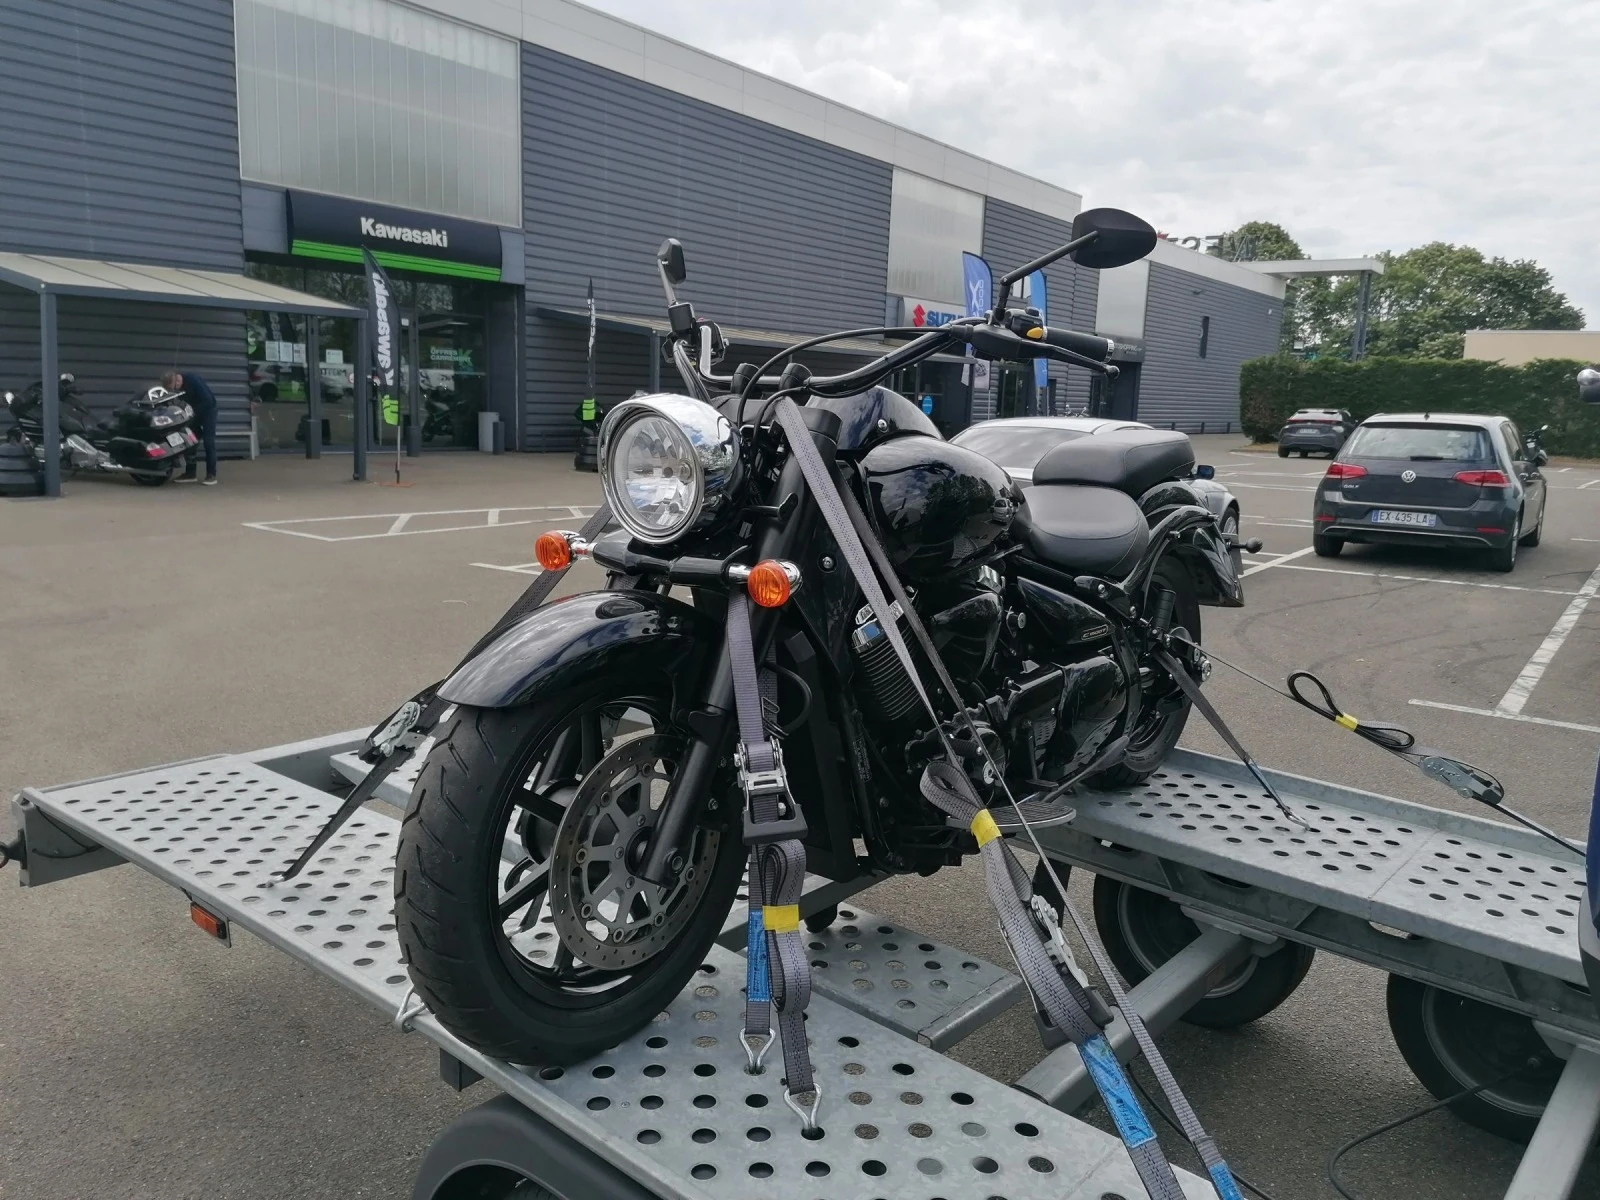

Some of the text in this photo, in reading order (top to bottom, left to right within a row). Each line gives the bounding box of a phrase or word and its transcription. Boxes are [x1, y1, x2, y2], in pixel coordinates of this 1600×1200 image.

[361, 217, 448, 248] Kawasaki
[927, 310, 965, 327] SUZ
[1379, 511, 1428, 524] EX-435-LA
